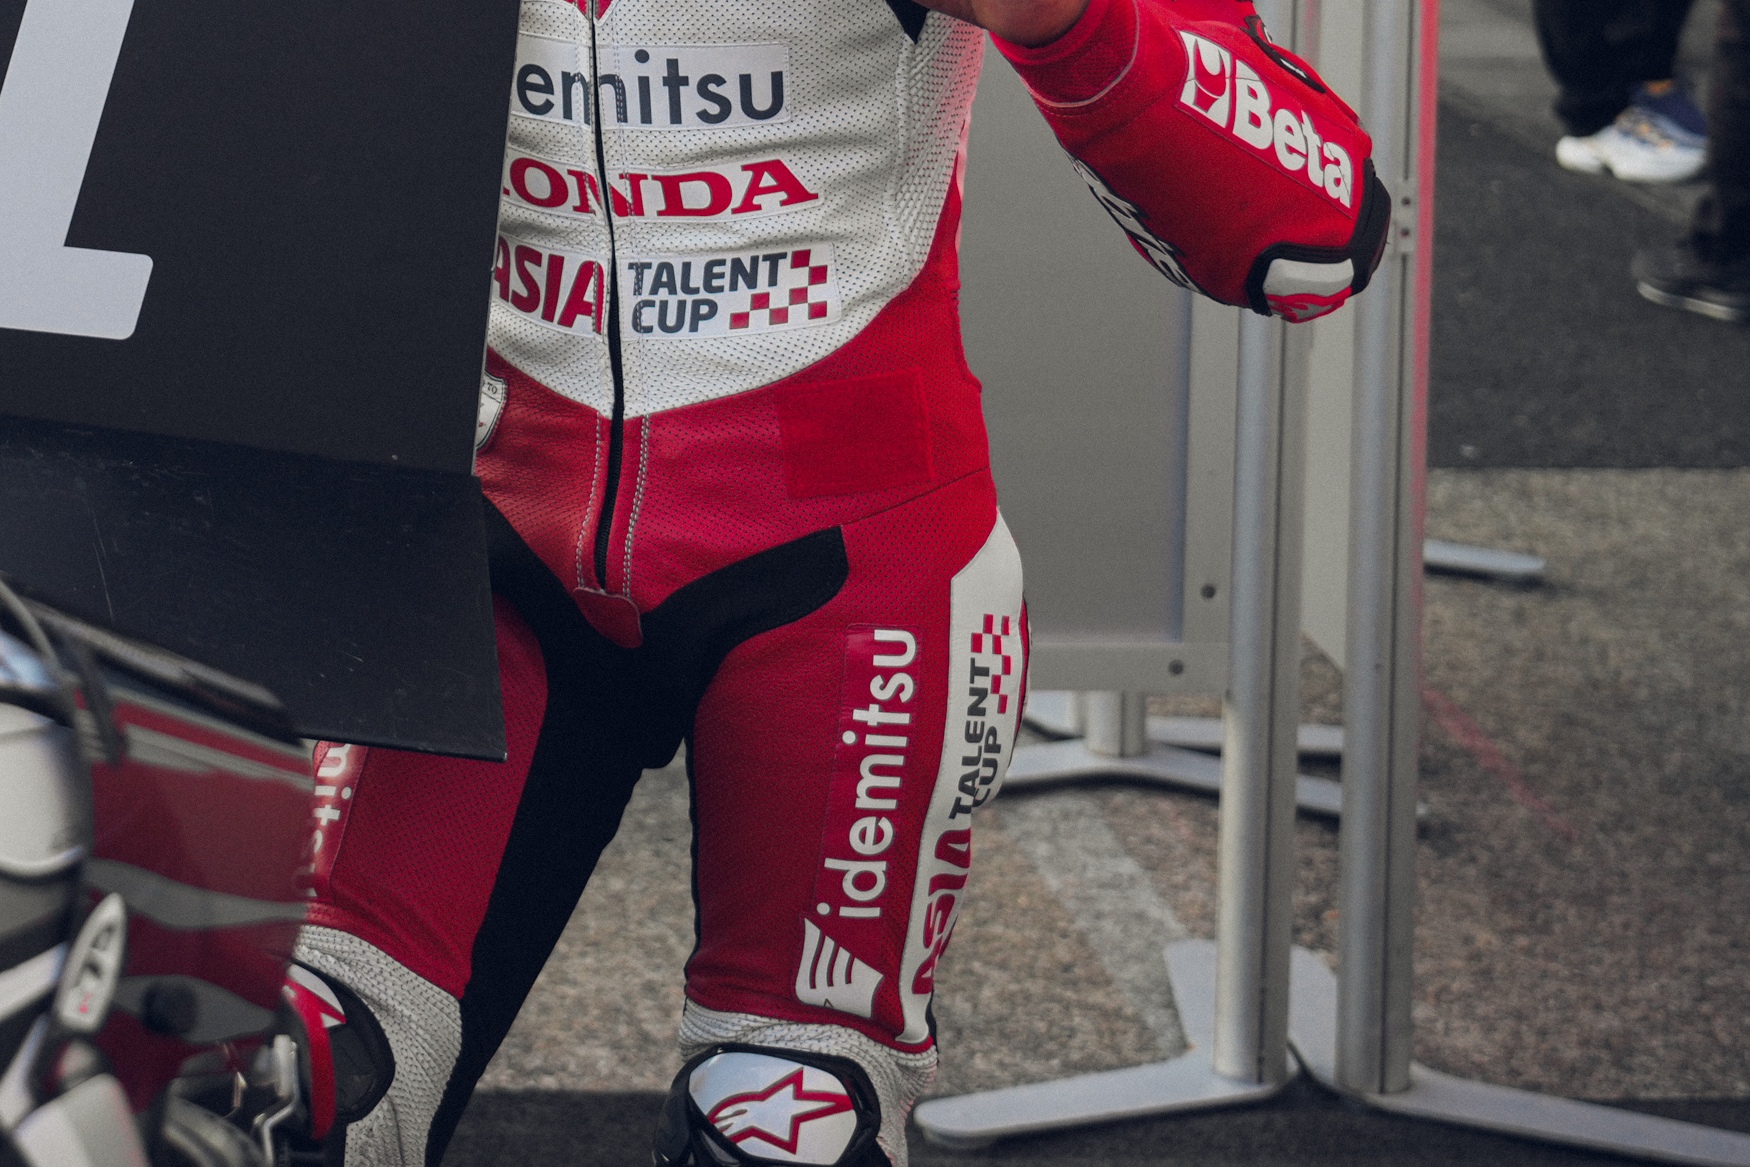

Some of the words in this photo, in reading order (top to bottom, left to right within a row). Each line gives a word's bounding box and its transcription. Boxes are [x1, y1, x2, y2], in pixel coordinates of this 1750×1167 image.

[516, 49, 784, 125] emitsu
[1233, 59, 1353, 209] Beta
[503, 158, 819, 218] ONDA
[627, 251, 788, 297] TALENT
[631, 297, 718, 334] CUP
[816, 629, 918, 919] idemitsu
[948, 657, 991, 821] TALENT
[972, 725, 1003, 810] CUP
